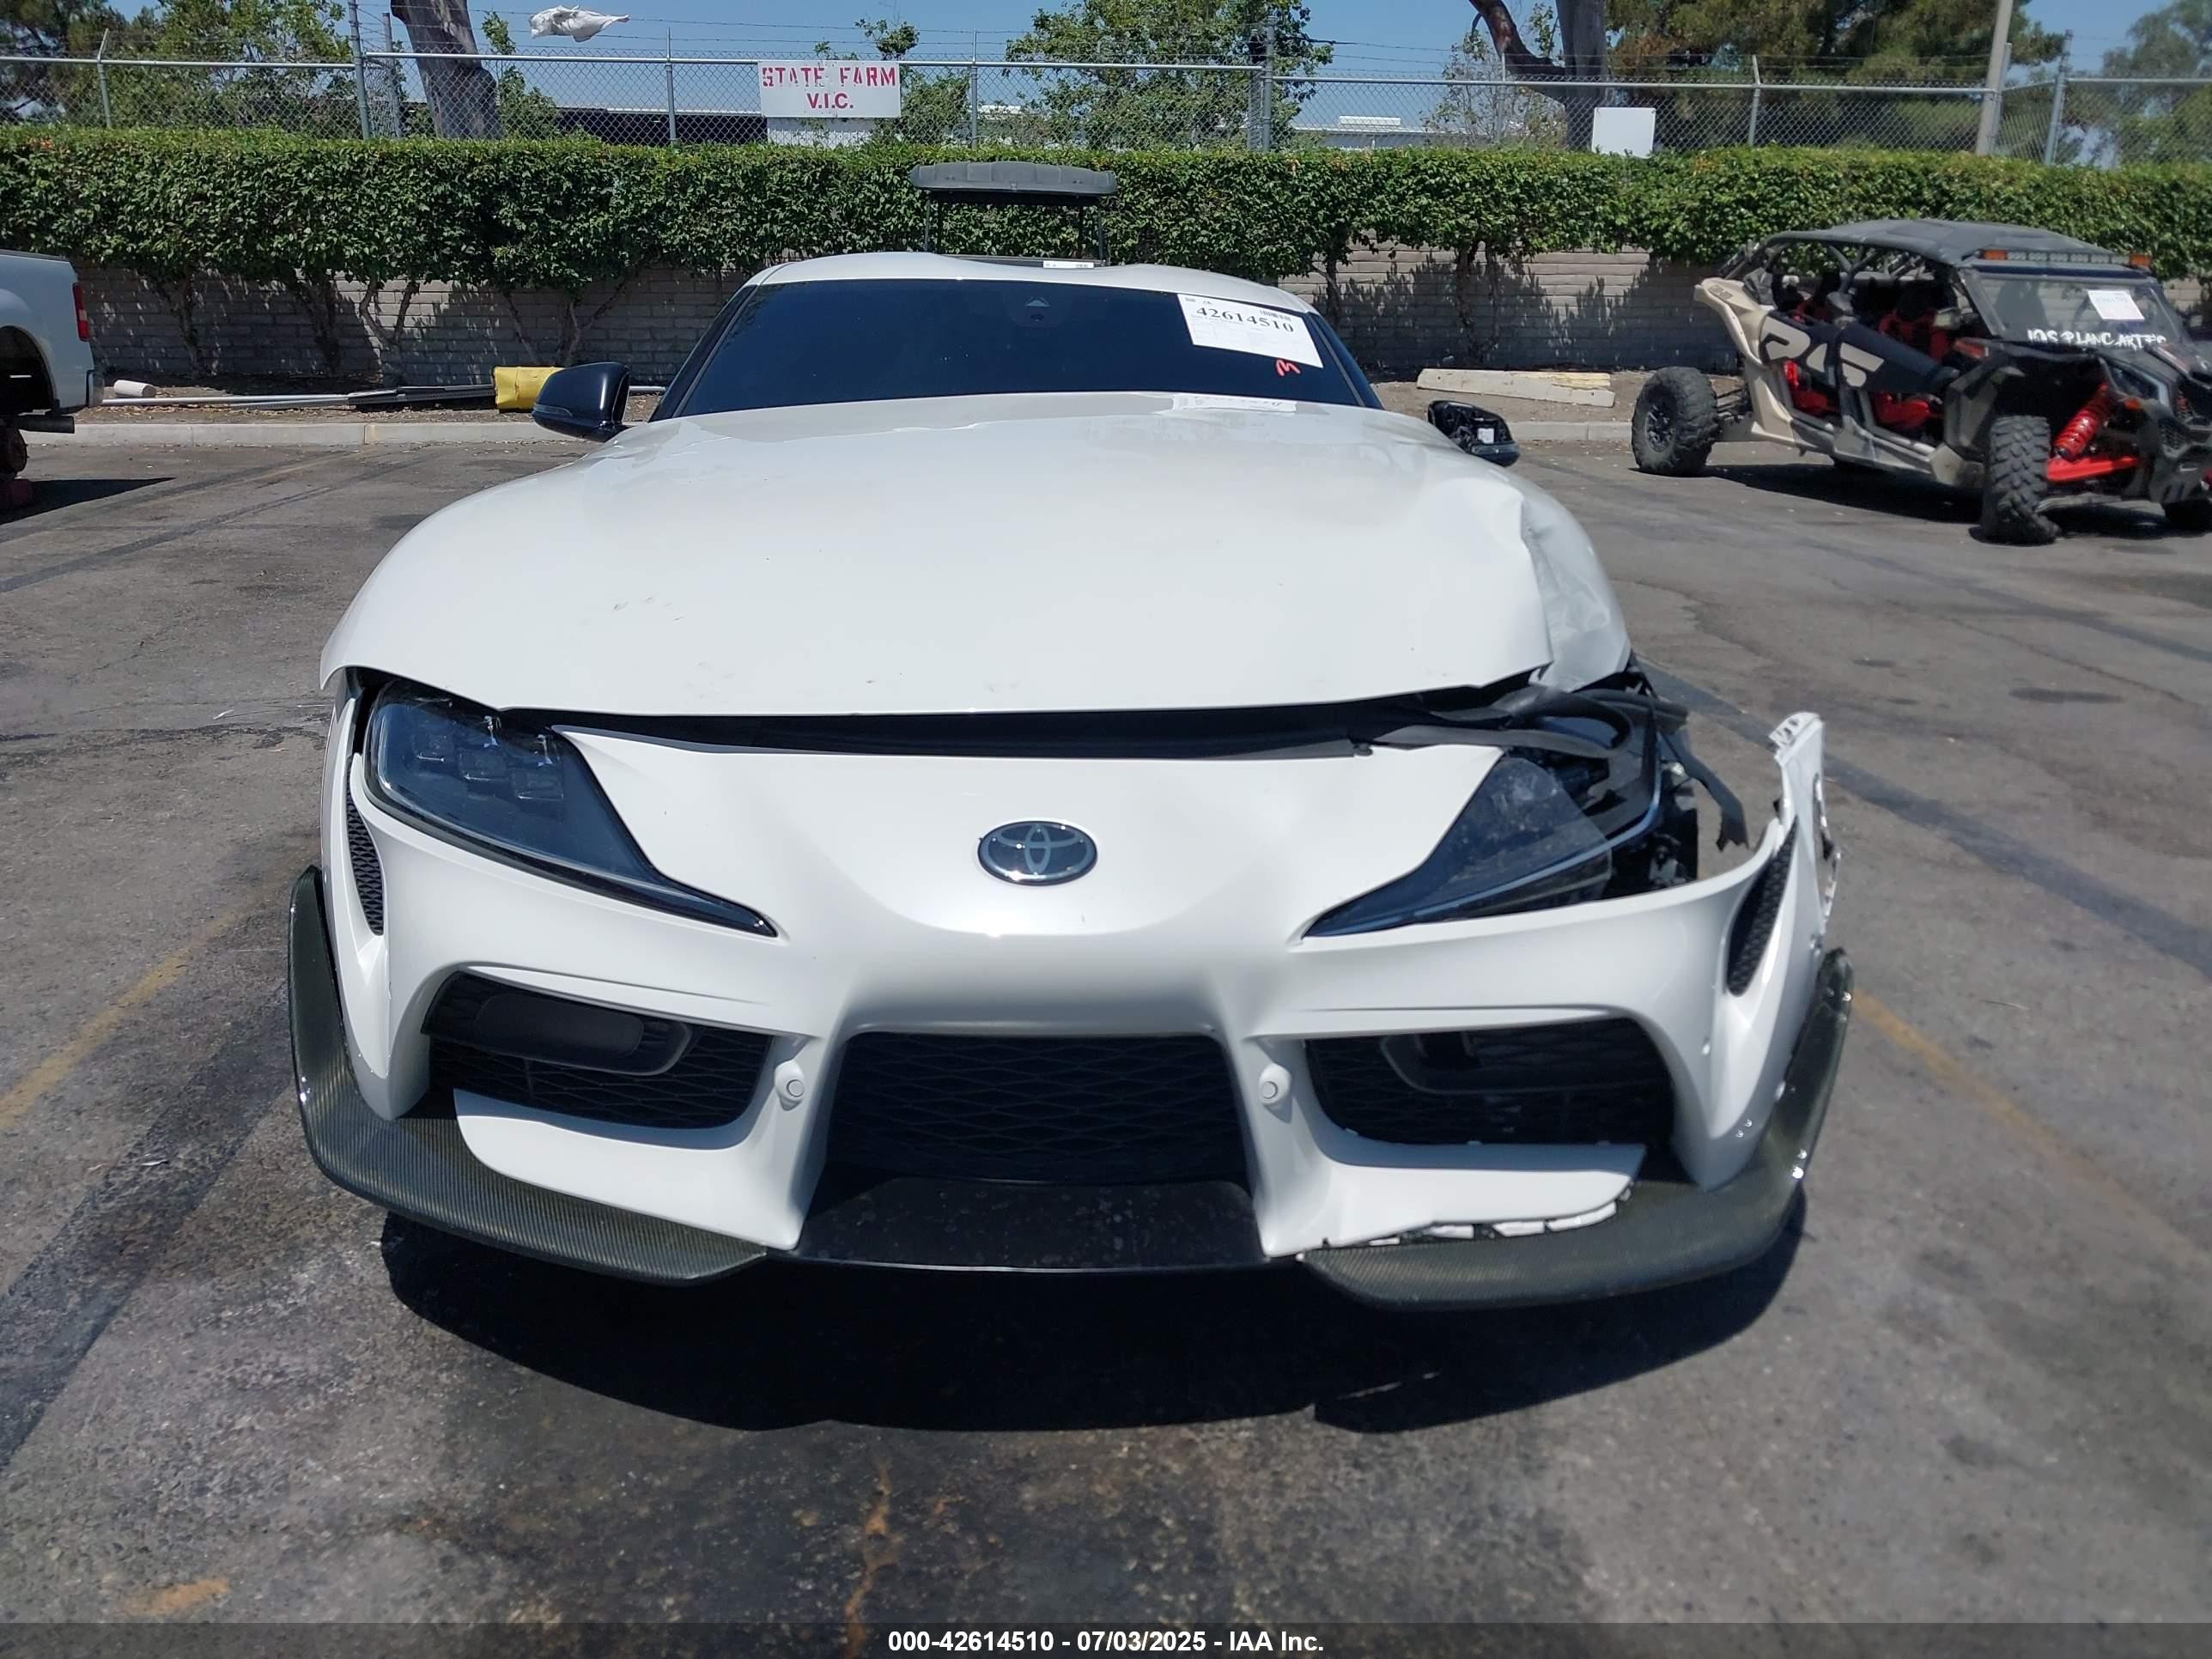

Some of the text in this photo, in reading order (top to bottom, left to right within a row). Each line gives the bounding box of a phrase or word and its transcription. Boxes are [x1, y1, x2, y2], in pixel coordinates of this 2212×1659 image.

[762, 66, 896, 88] STATE FARM
[806, 92, 854, 109] V.I.C.
[1196, 307, 1294, 332] 42614510
